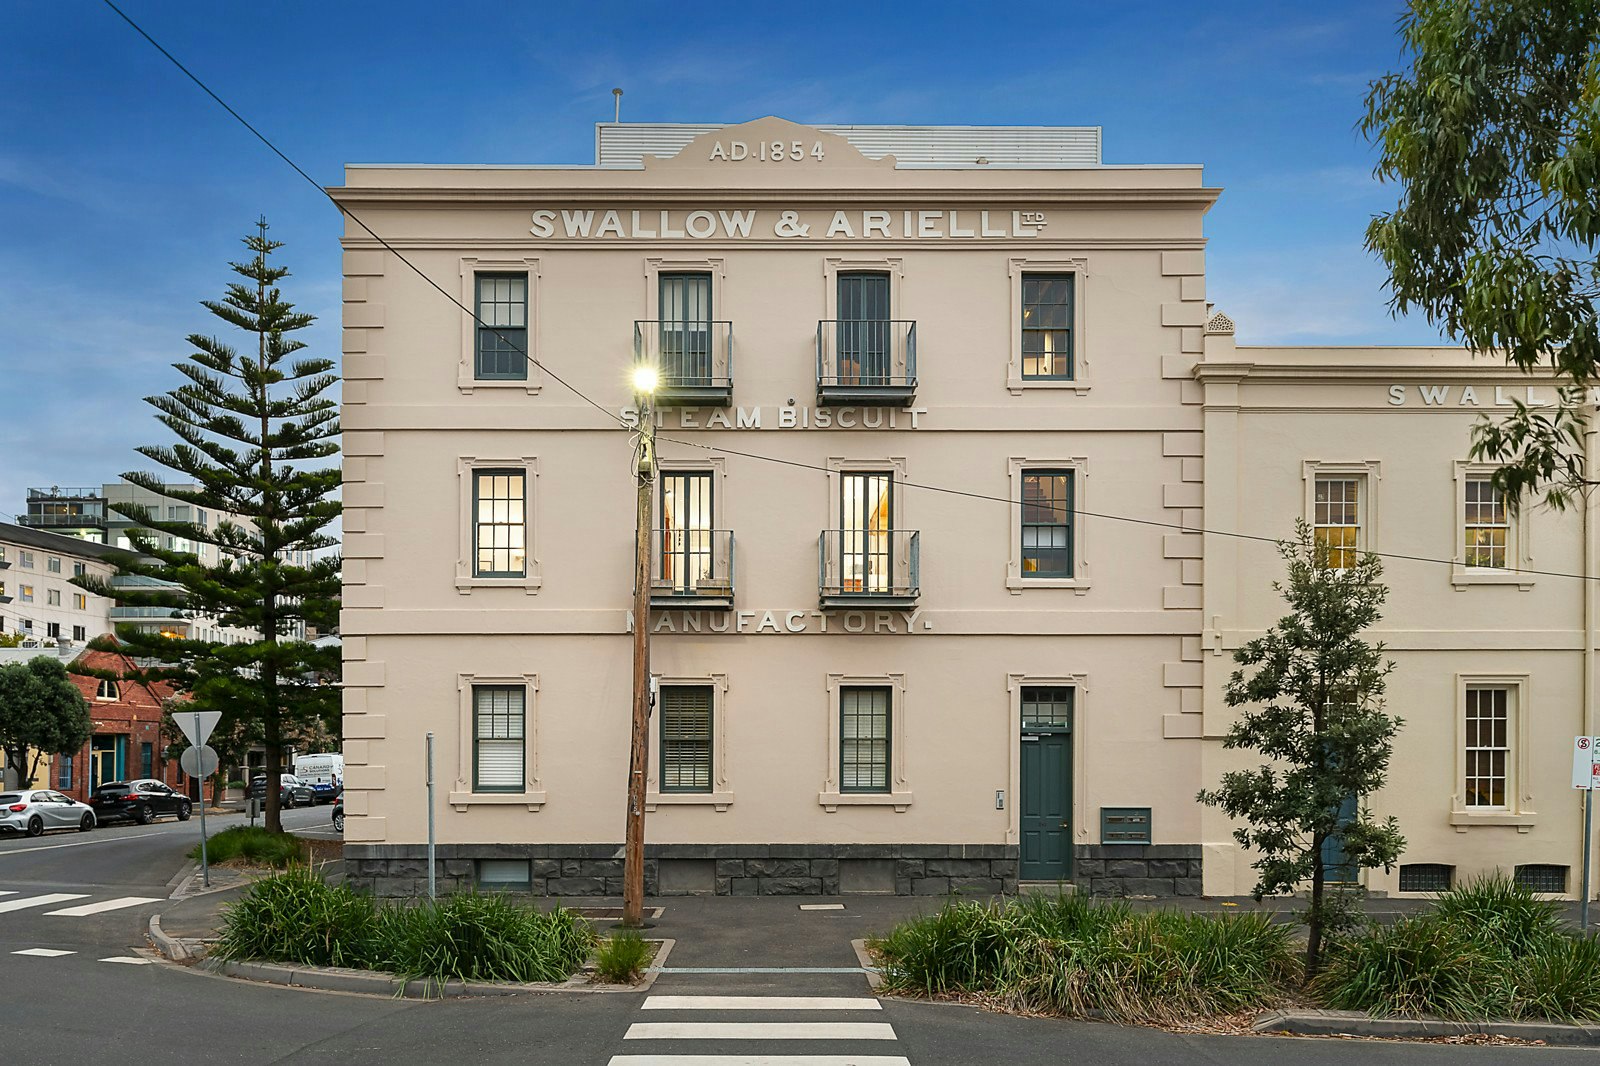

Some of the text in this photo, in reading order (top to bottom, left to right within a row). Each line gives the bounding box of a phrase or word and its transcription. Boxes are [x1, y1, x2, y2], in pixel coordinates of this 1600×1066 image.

[529, 209, 757, 238] SWALLOW
[774, 210, 810, 238] &
[825, 210, 1007, 238] ARIELL
[778, 405, 928, 429] BISCUIT
